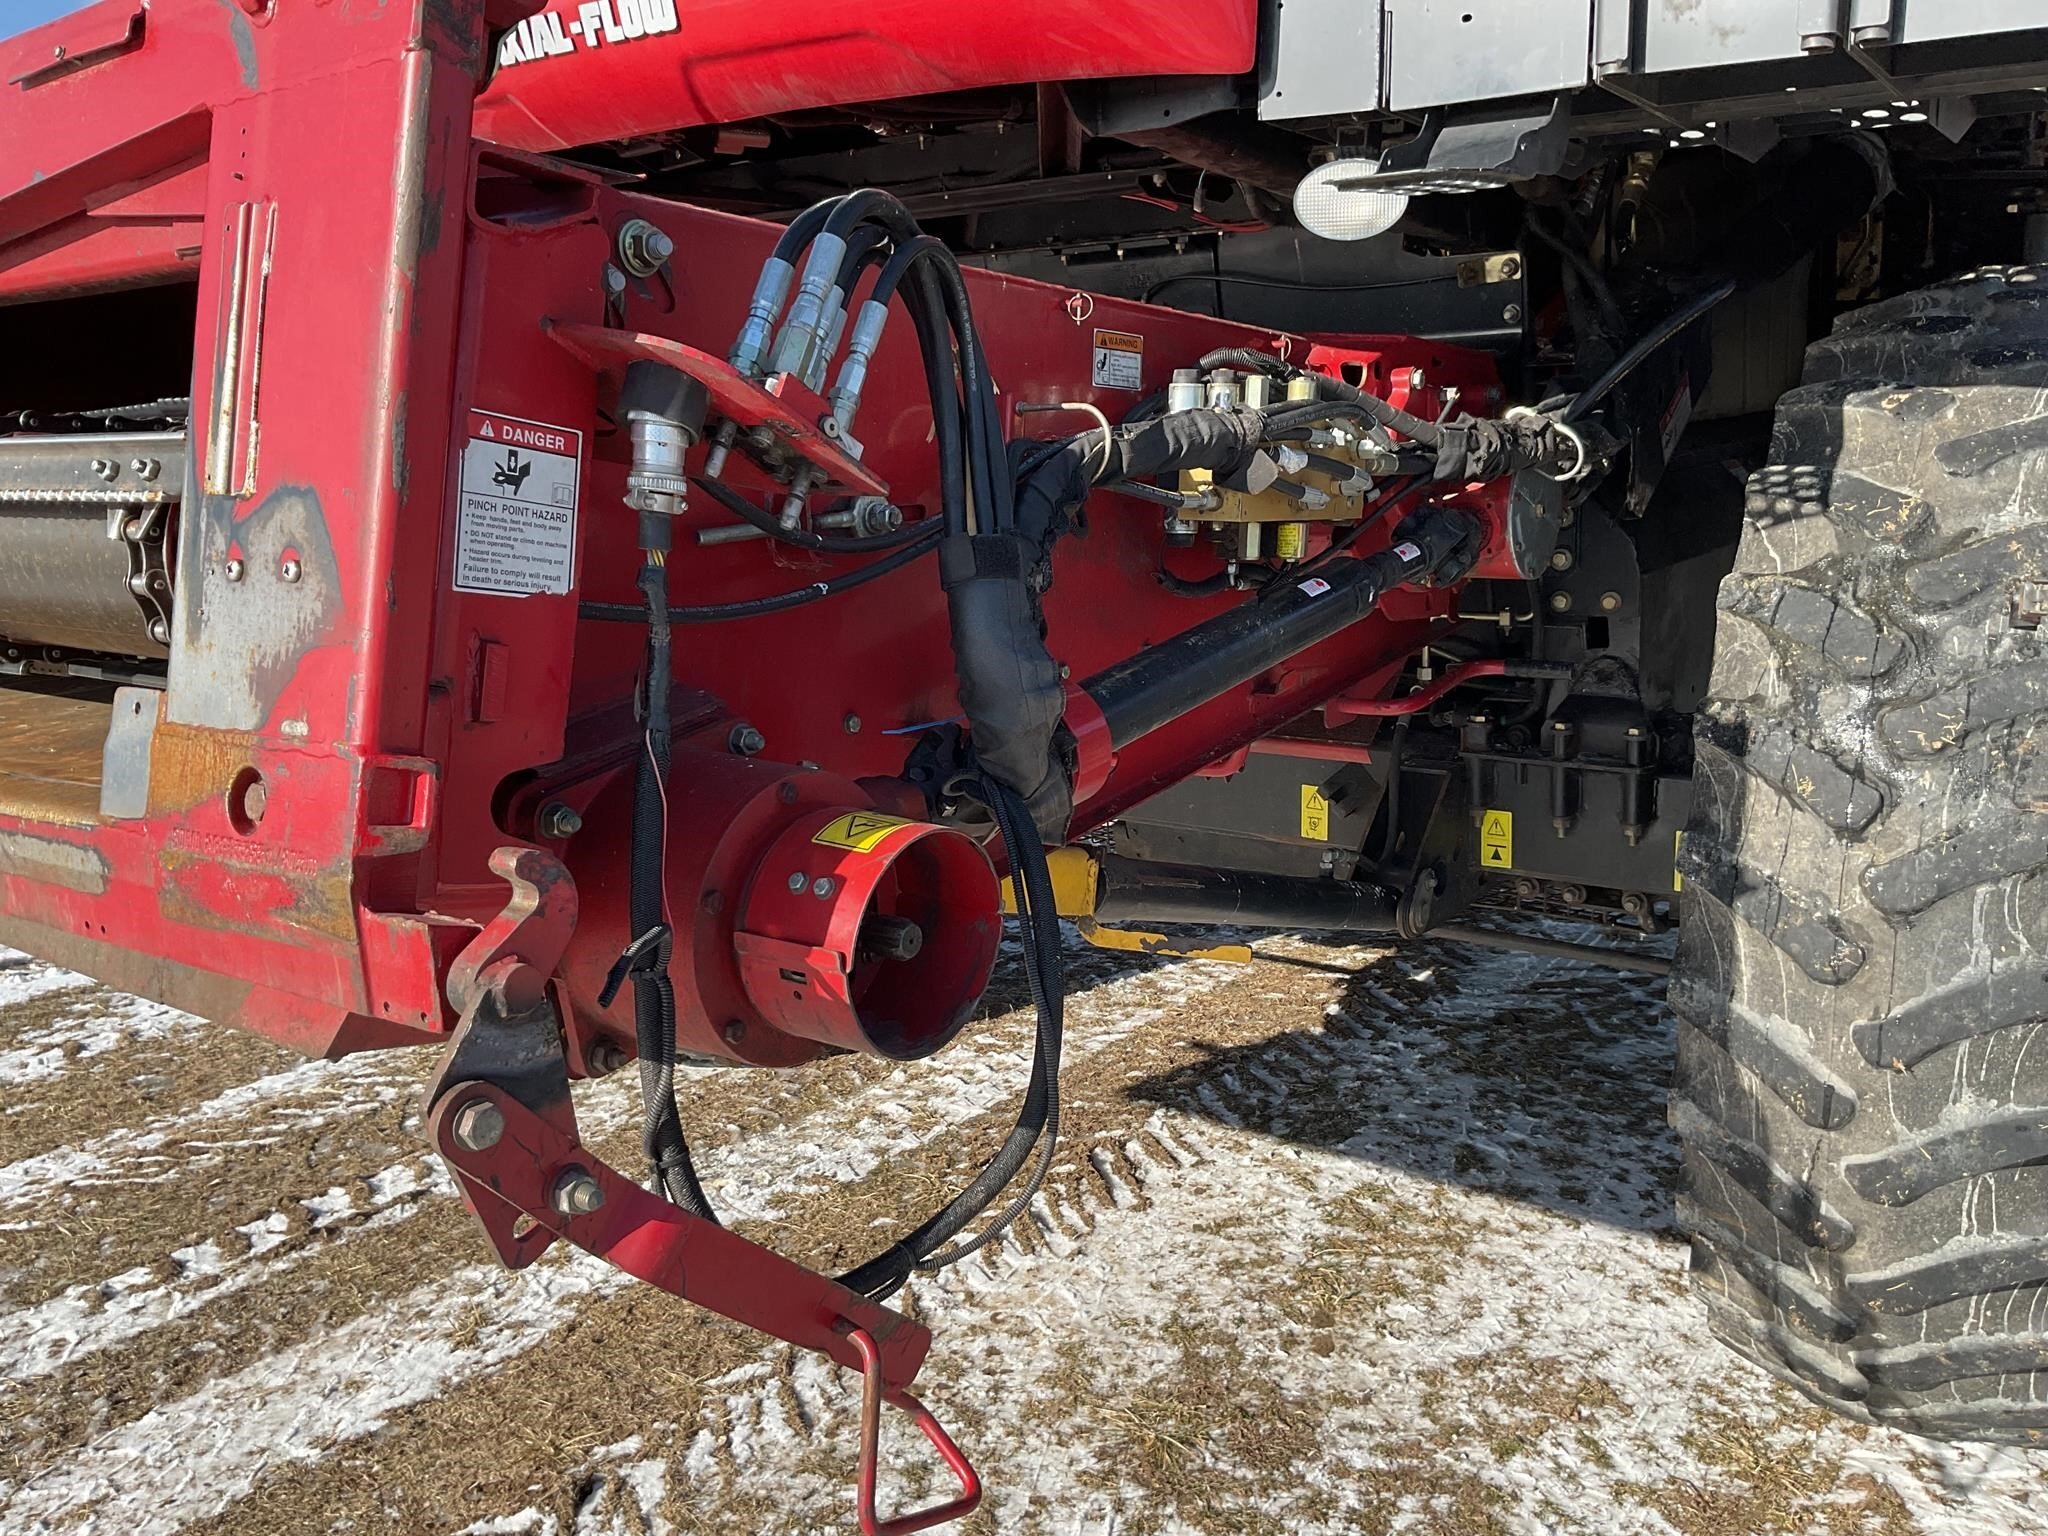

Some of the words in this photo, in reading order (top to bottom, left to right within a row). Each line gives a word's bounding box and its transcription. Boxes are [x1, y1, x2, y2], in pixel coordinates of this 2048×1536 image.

[1108, 336, 1137, 348] WARNING
[502, 425, 565, 450] DANGER
[468, 499, 497, 512] PINCH
[502, 504, 530, 518] POINT
[532, 508, 568, 523] HAZARD
[471, 513, 487, 521] Keep
[534, 522, 547, 531] body
[471, 519, 485, 527] from
[486, 523, 507, 532] moving
[470, 529, 480, 537] DO
[481, 532, 494, 540] NOT
[495, 534, 511, 542] stand
[520, 537, 535, 545] climb
[544, 541, 567, 549] machine
[468, 555, 490, 563] header
[469, 548, 490, 556] Hazard
[490, 551, 510, 559] occurs
[512, 554, 531, 563] during
[531, 556, 553, 565] leveling
[463, 563, 489, 574] Failure
[491, 567, 499, 575] to
[500, 569, 527, 580] comply
[528, 570, 541, 580] will
[541, 573, 561, 582] result
[471, 574, 492, 584] death
[503, 580, 529, 588] serious
[530, 581, 552, 591] injury.
